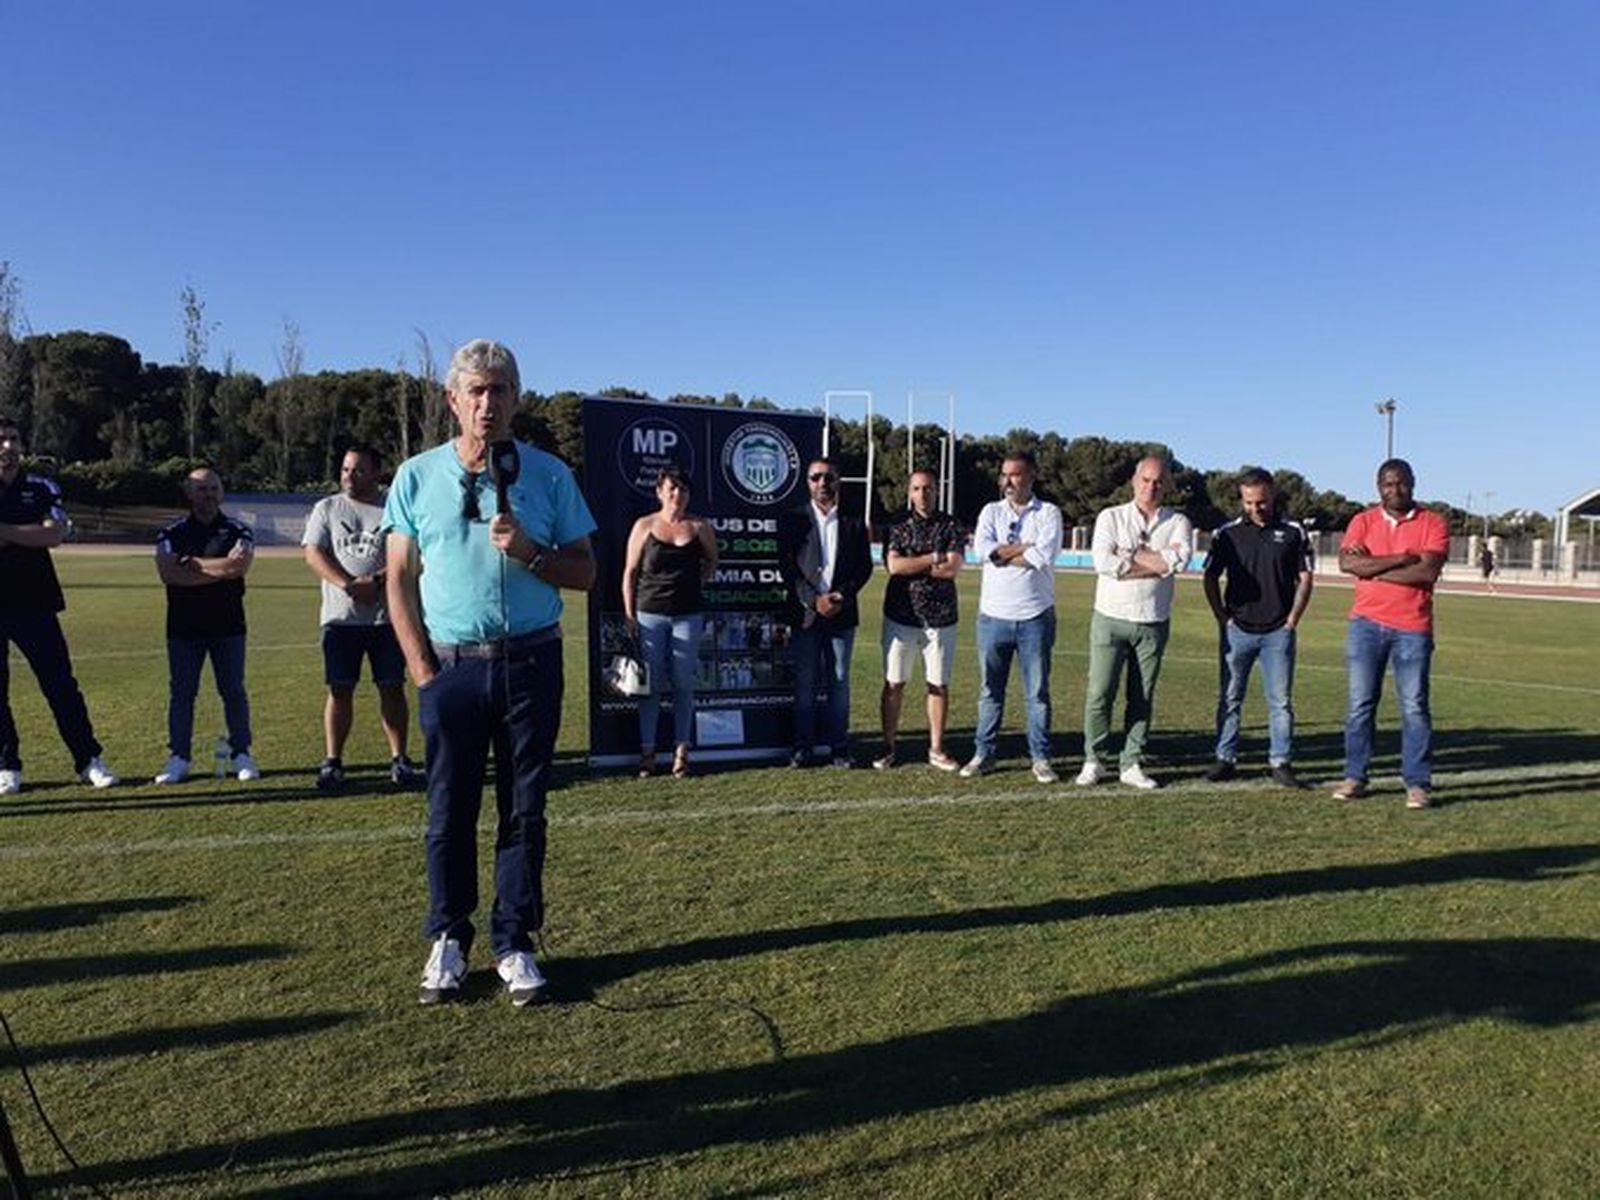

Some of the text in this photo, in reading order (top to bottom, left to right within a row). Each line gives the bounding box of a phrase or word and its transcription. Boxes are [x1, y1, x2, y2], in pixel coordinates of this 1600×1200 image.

[632, 427, 677, 455] MP
[709, 518, 778, 533] US DE
[733, 538, 778, 553] 202
[713, 569, 756, 583] MIA
